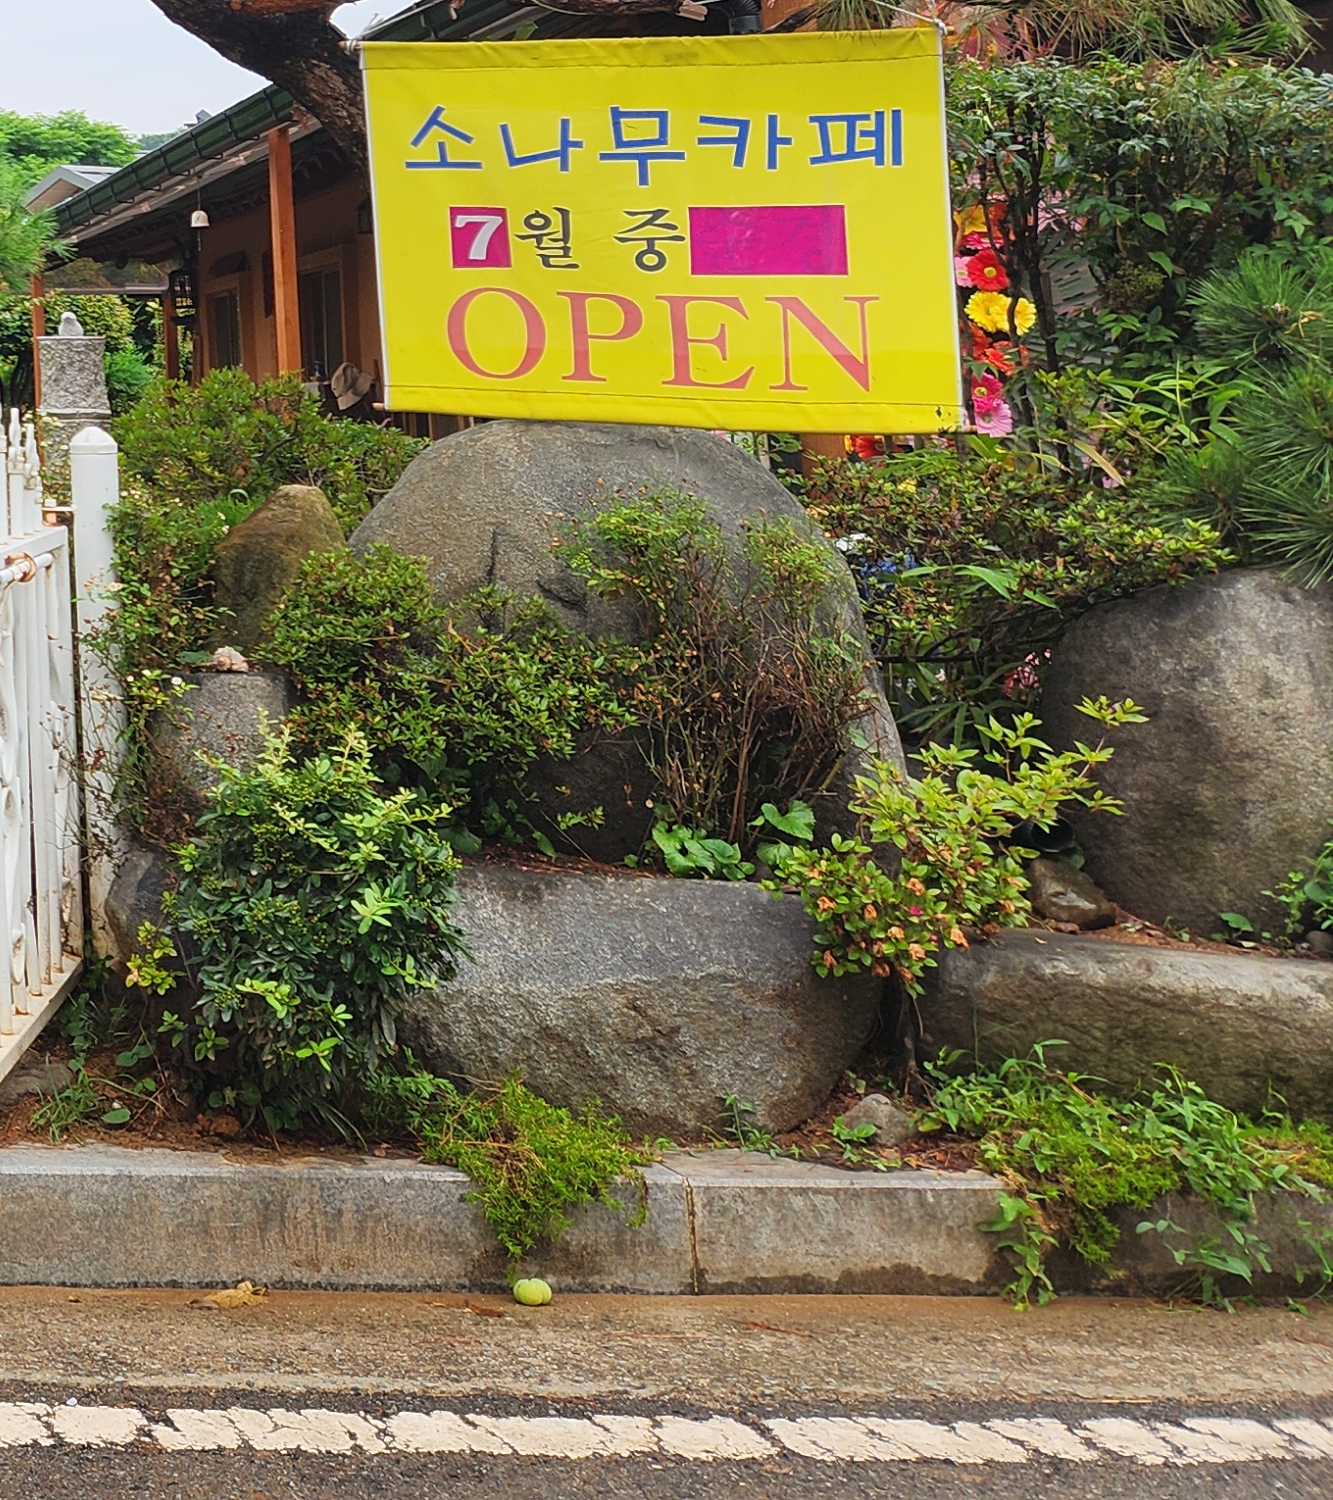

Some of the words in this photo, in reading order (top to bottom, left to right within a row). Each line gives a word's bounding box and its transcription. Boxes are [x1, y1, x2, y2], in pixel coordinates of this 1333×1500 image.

[404, 104, 904, 187] 소나무카페
[452, 206, 580, 270] 7월
[447, 286, 880, 393] OPEN
